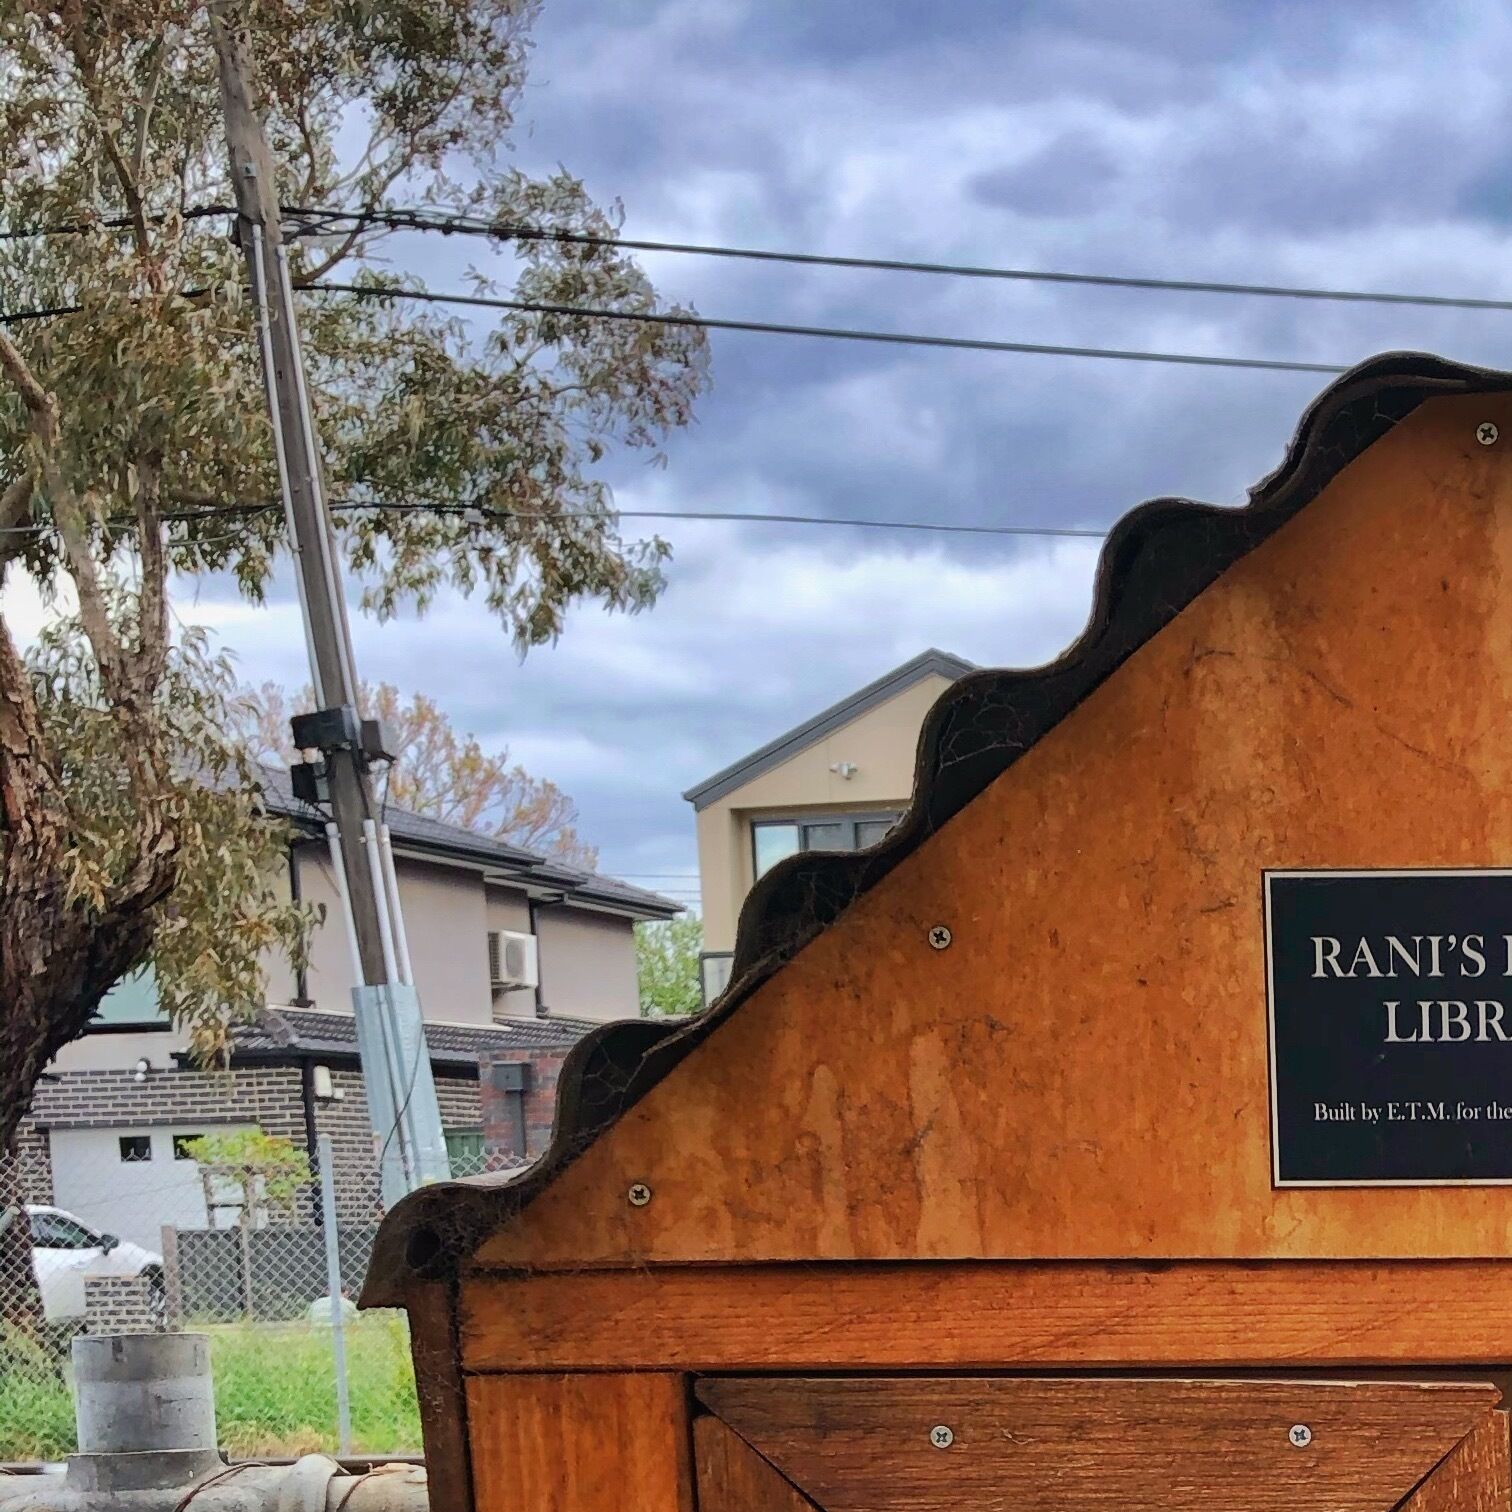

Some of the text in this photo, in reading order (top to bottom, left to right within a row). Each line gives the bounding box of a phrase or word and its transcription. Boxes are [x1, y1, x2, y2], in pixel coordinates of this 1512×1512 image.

[1310, 934, 1487, 979] RANI'S
[1313, 1102, 1356, 1122] Built
[1361, 1101, 1383, 1125] by
[1386, 1101, 1451, 1122] E.T.M.
[1456, 1100, 1482, 1121] for
